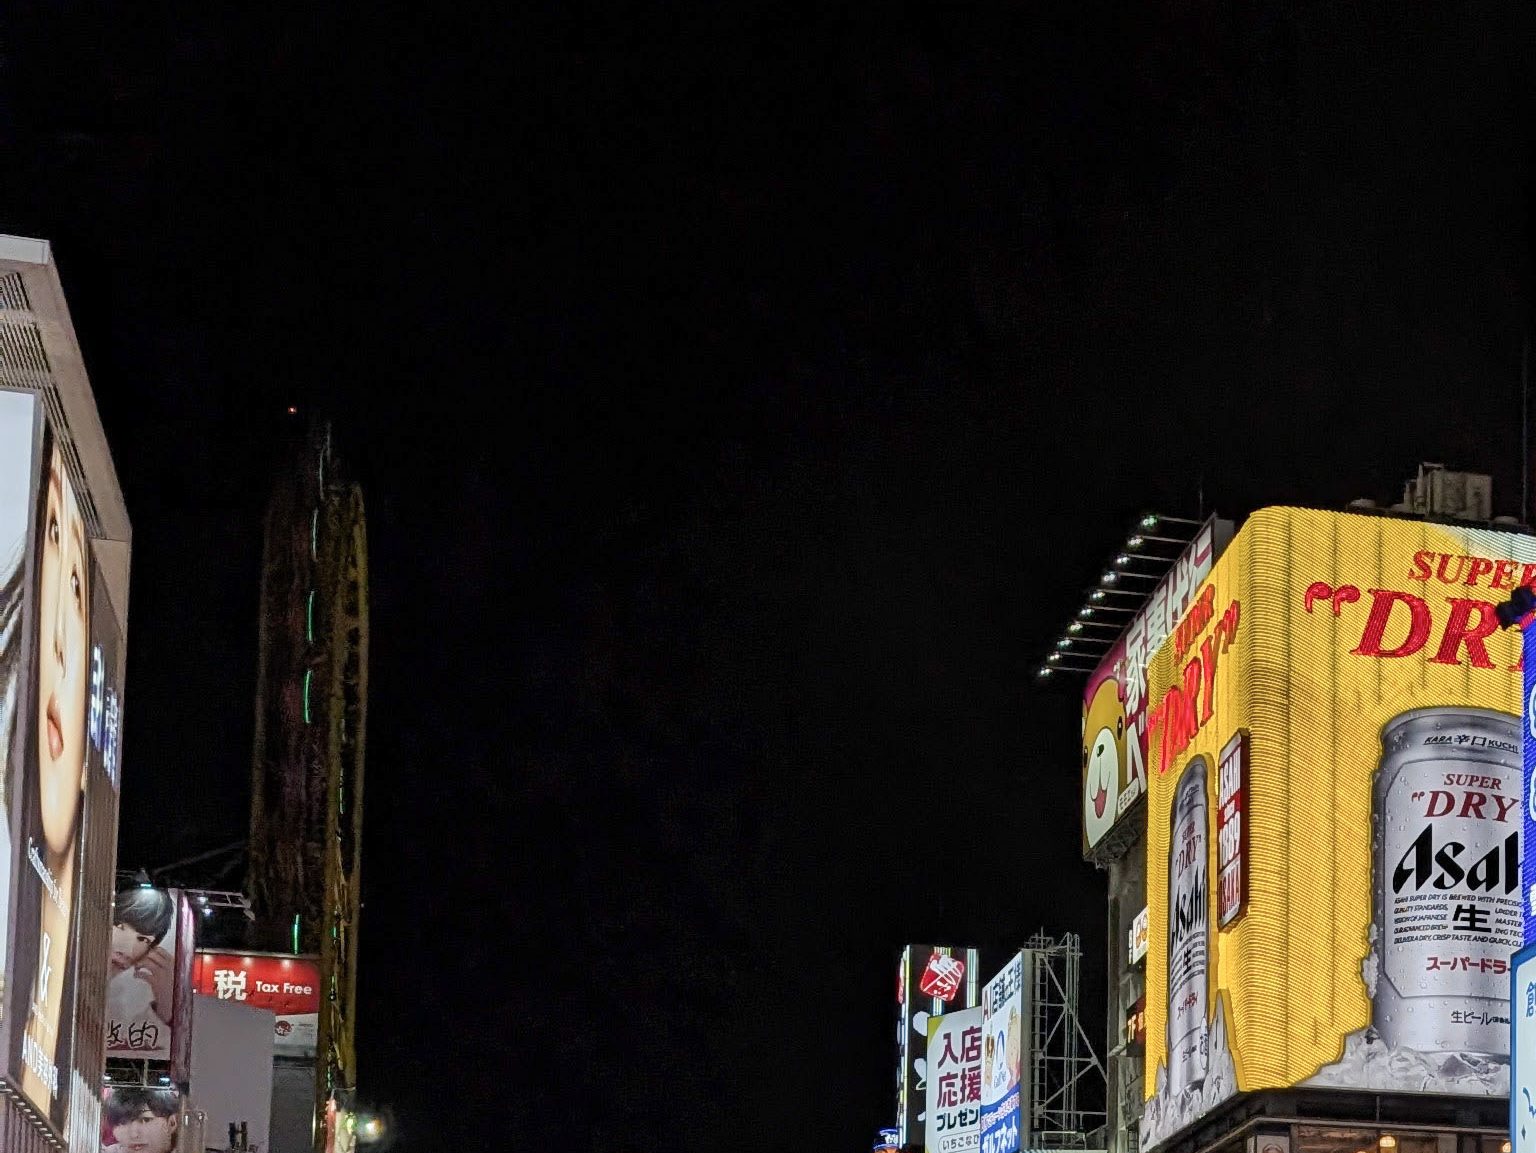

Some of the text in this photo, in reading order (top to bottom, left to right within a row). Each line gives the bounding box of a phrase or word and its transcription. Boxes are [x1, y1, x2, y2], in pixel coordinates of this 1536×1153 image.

[1304, 581, 1524, 672] “DR
[1444, 773, 1502, 790] SUPER
[1452, 904, 1491, 933] 生
[1426, 956, 1510, 975] スーパードラ
[214, 969, 312, 1001] 税 Tax Free
[937, 1026, 981, 1069] 入店
[937, 1065, 981, 1109] 応援
